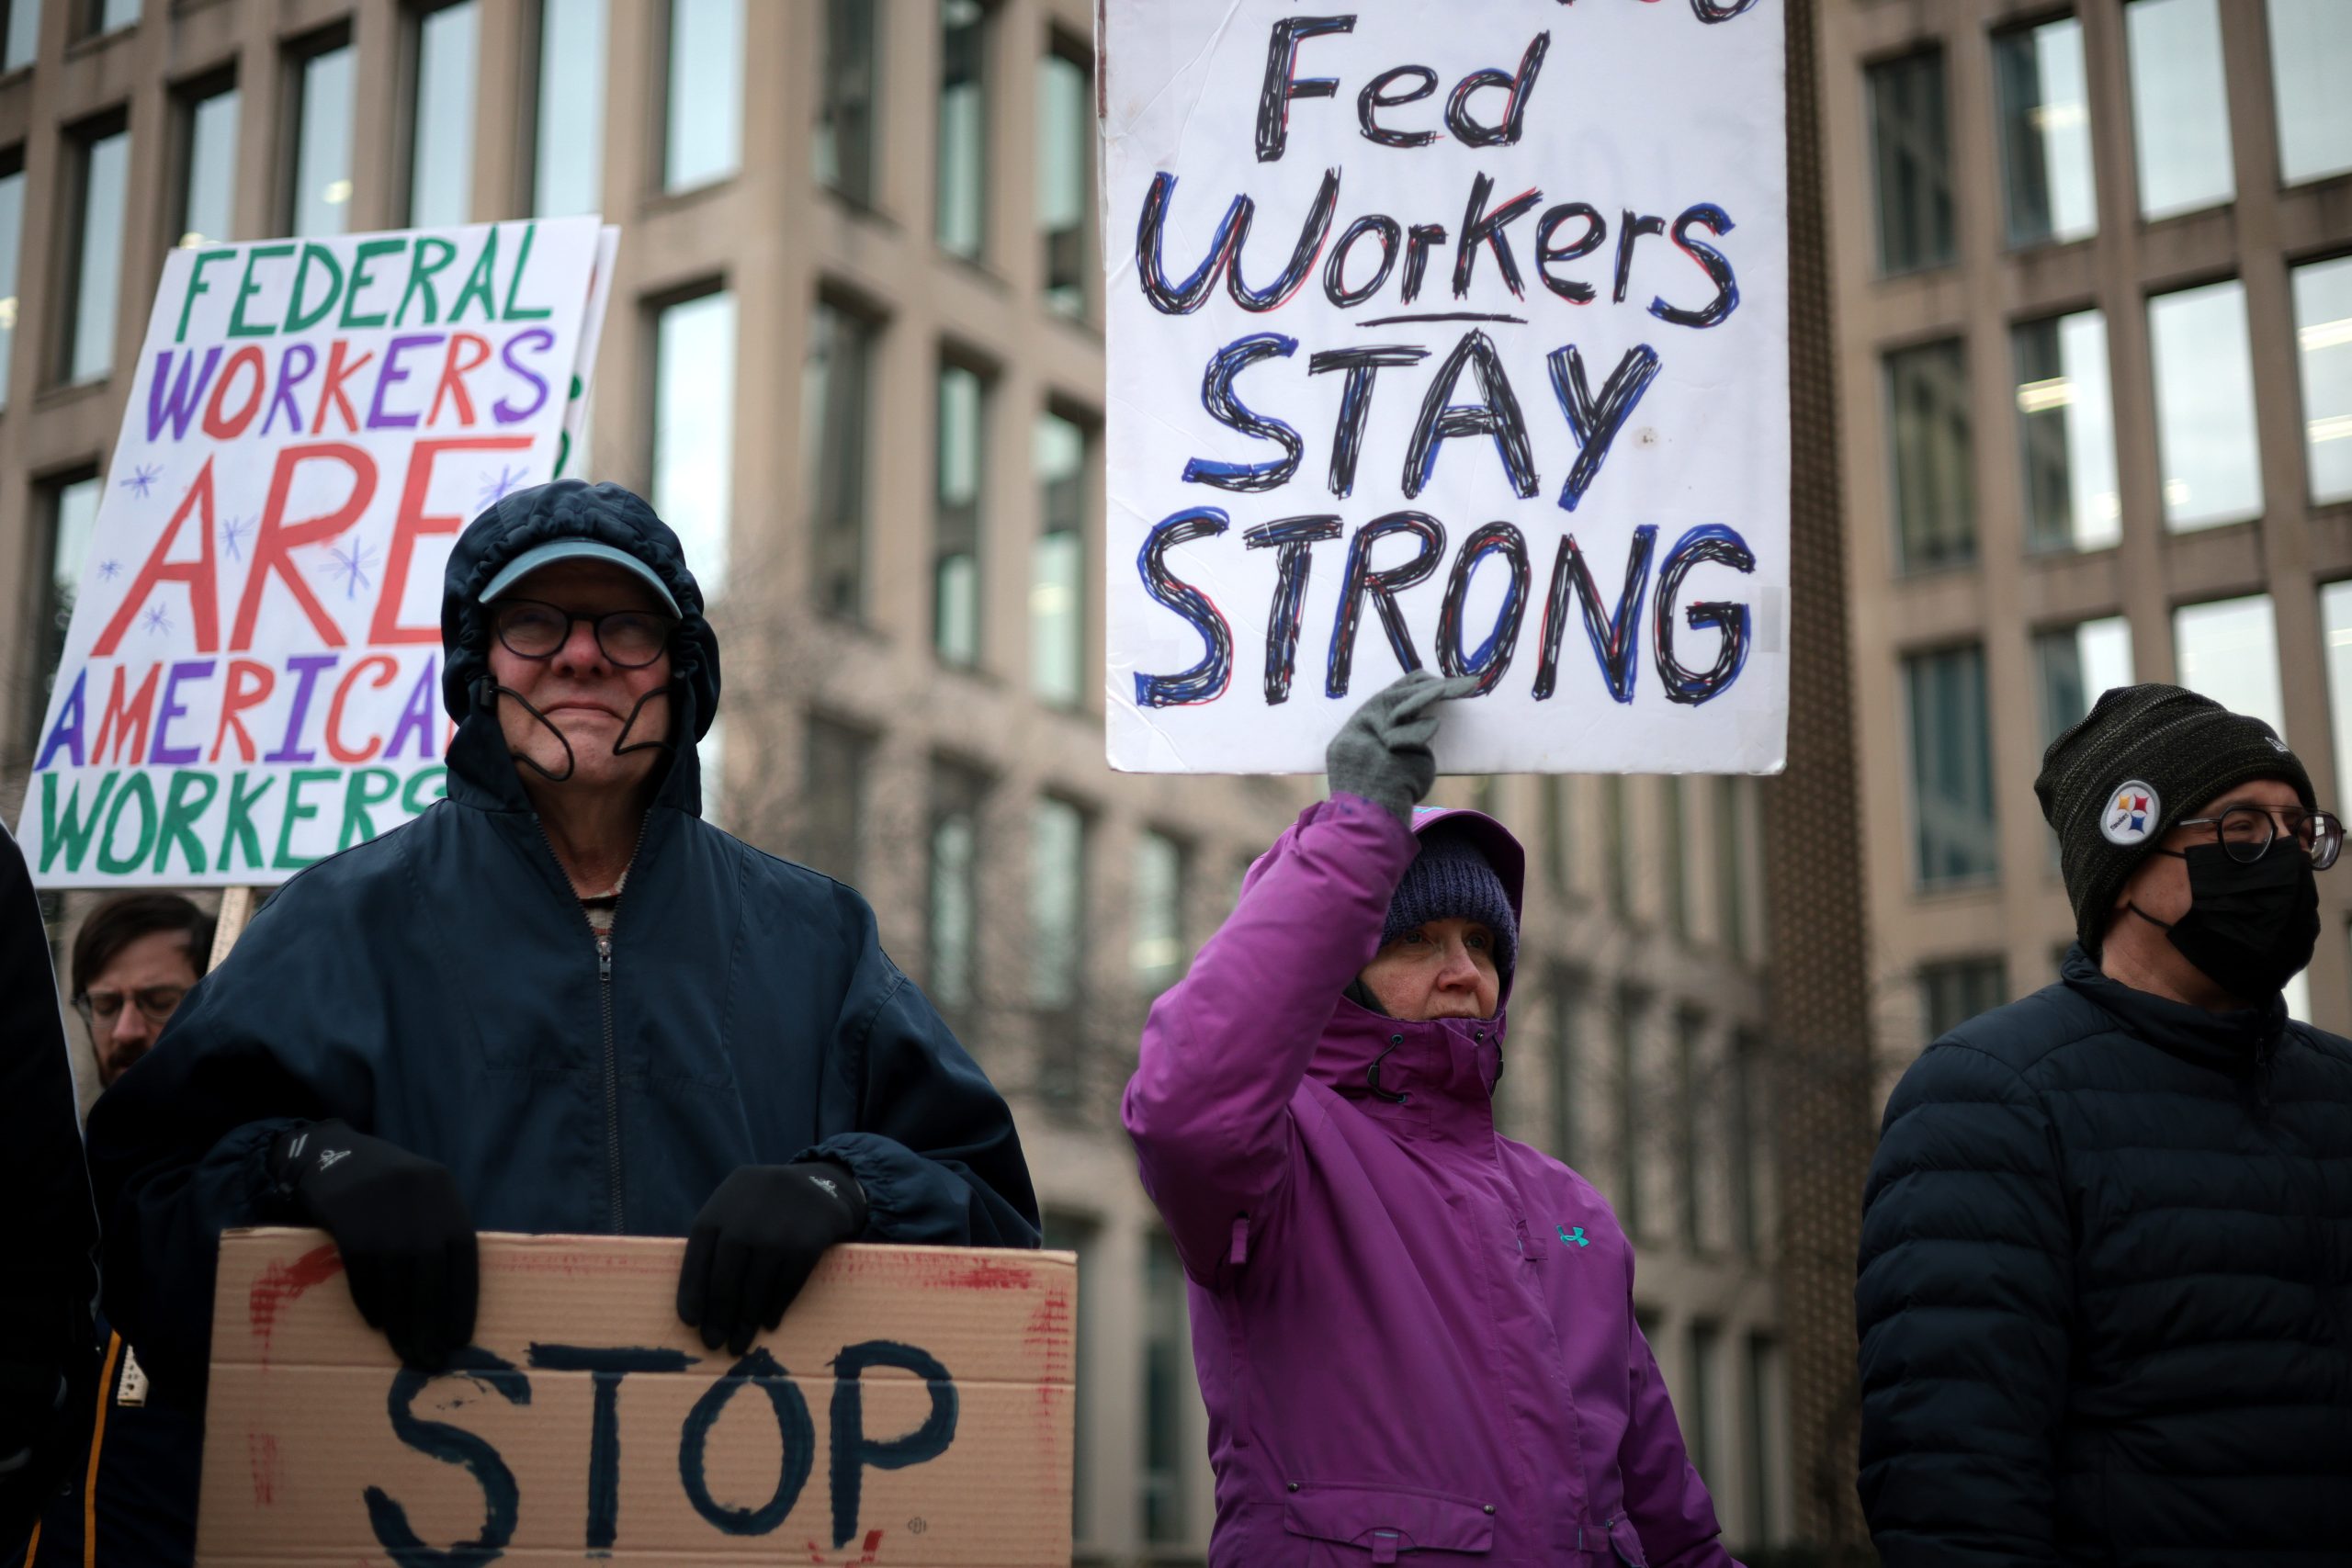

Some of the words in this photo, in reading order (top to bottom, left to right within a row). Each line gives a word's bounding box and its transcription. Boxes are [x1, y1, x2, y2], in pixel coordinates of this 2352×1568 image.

[1254, 15, 1551, 163] Fed
[175, 221, 552, 342] FEDERAL
[146, 328, 556, 442] WORKERS
[1182, 327, 1661, 512] STAY
[90, 436, 535, 658] ARE
[1134, 506, 1756, 707] STRONG
[34, 653, 459, 772] AMERICA
[2110, 813, 2130, 831] Steelers
[363, 1340, 960, 1568] STOP
